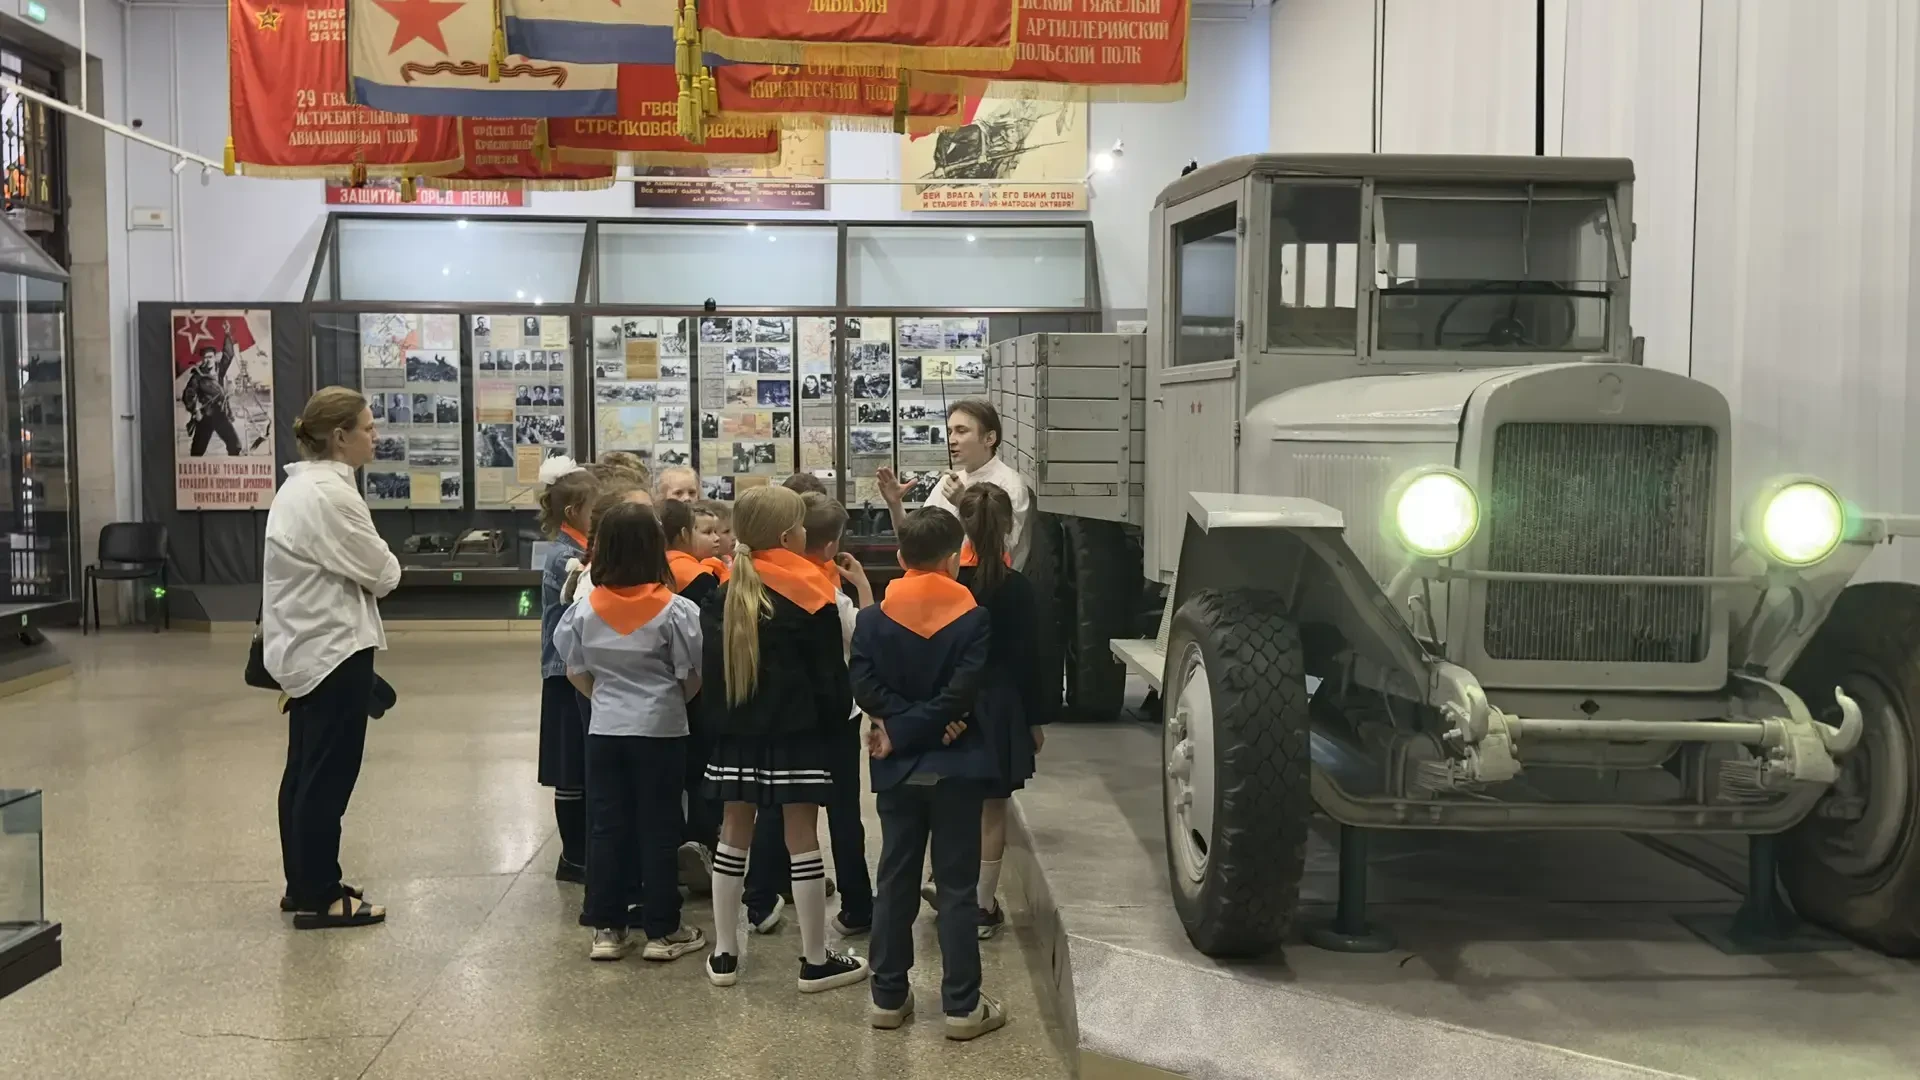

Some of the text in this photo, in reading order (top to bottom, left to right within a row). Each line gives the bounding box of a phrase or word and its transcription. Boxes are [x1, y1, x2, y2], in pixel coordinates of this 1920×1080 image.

[307, 8, 346, 19] СМЕР
[807, 0, 887, 13] ДИВИЗИЯ
[1026, 17, 1169, 40] АРТИЛЛЕРИЙСКИЙ
[1016, 42, 1142, 64] ПОЛЬСКИЙ ПОЛК
[297, 89, 316, 108] 29
[750, 80, 858, 100] КИРКЕНЕССКИЙ
[288, 128, 418, 146] АВИАЦИОННЫЙ ПОЛК
[704, 121, 768, 139] ИВИЗИЯ
[461, 189, 510, 206] ЛЕНИНА
[922, 191, 941, 200] БЕЙ
[946, 191, 975, 200] ВРАГА
[1002, 191, 1020, 200] ЕГО
[1023, 191, 1047, 200] БИЛИ
[1050, 191, 1075, 201] ОТЦЫ
[932, 200, 968, 208] СТАРШИЕ
